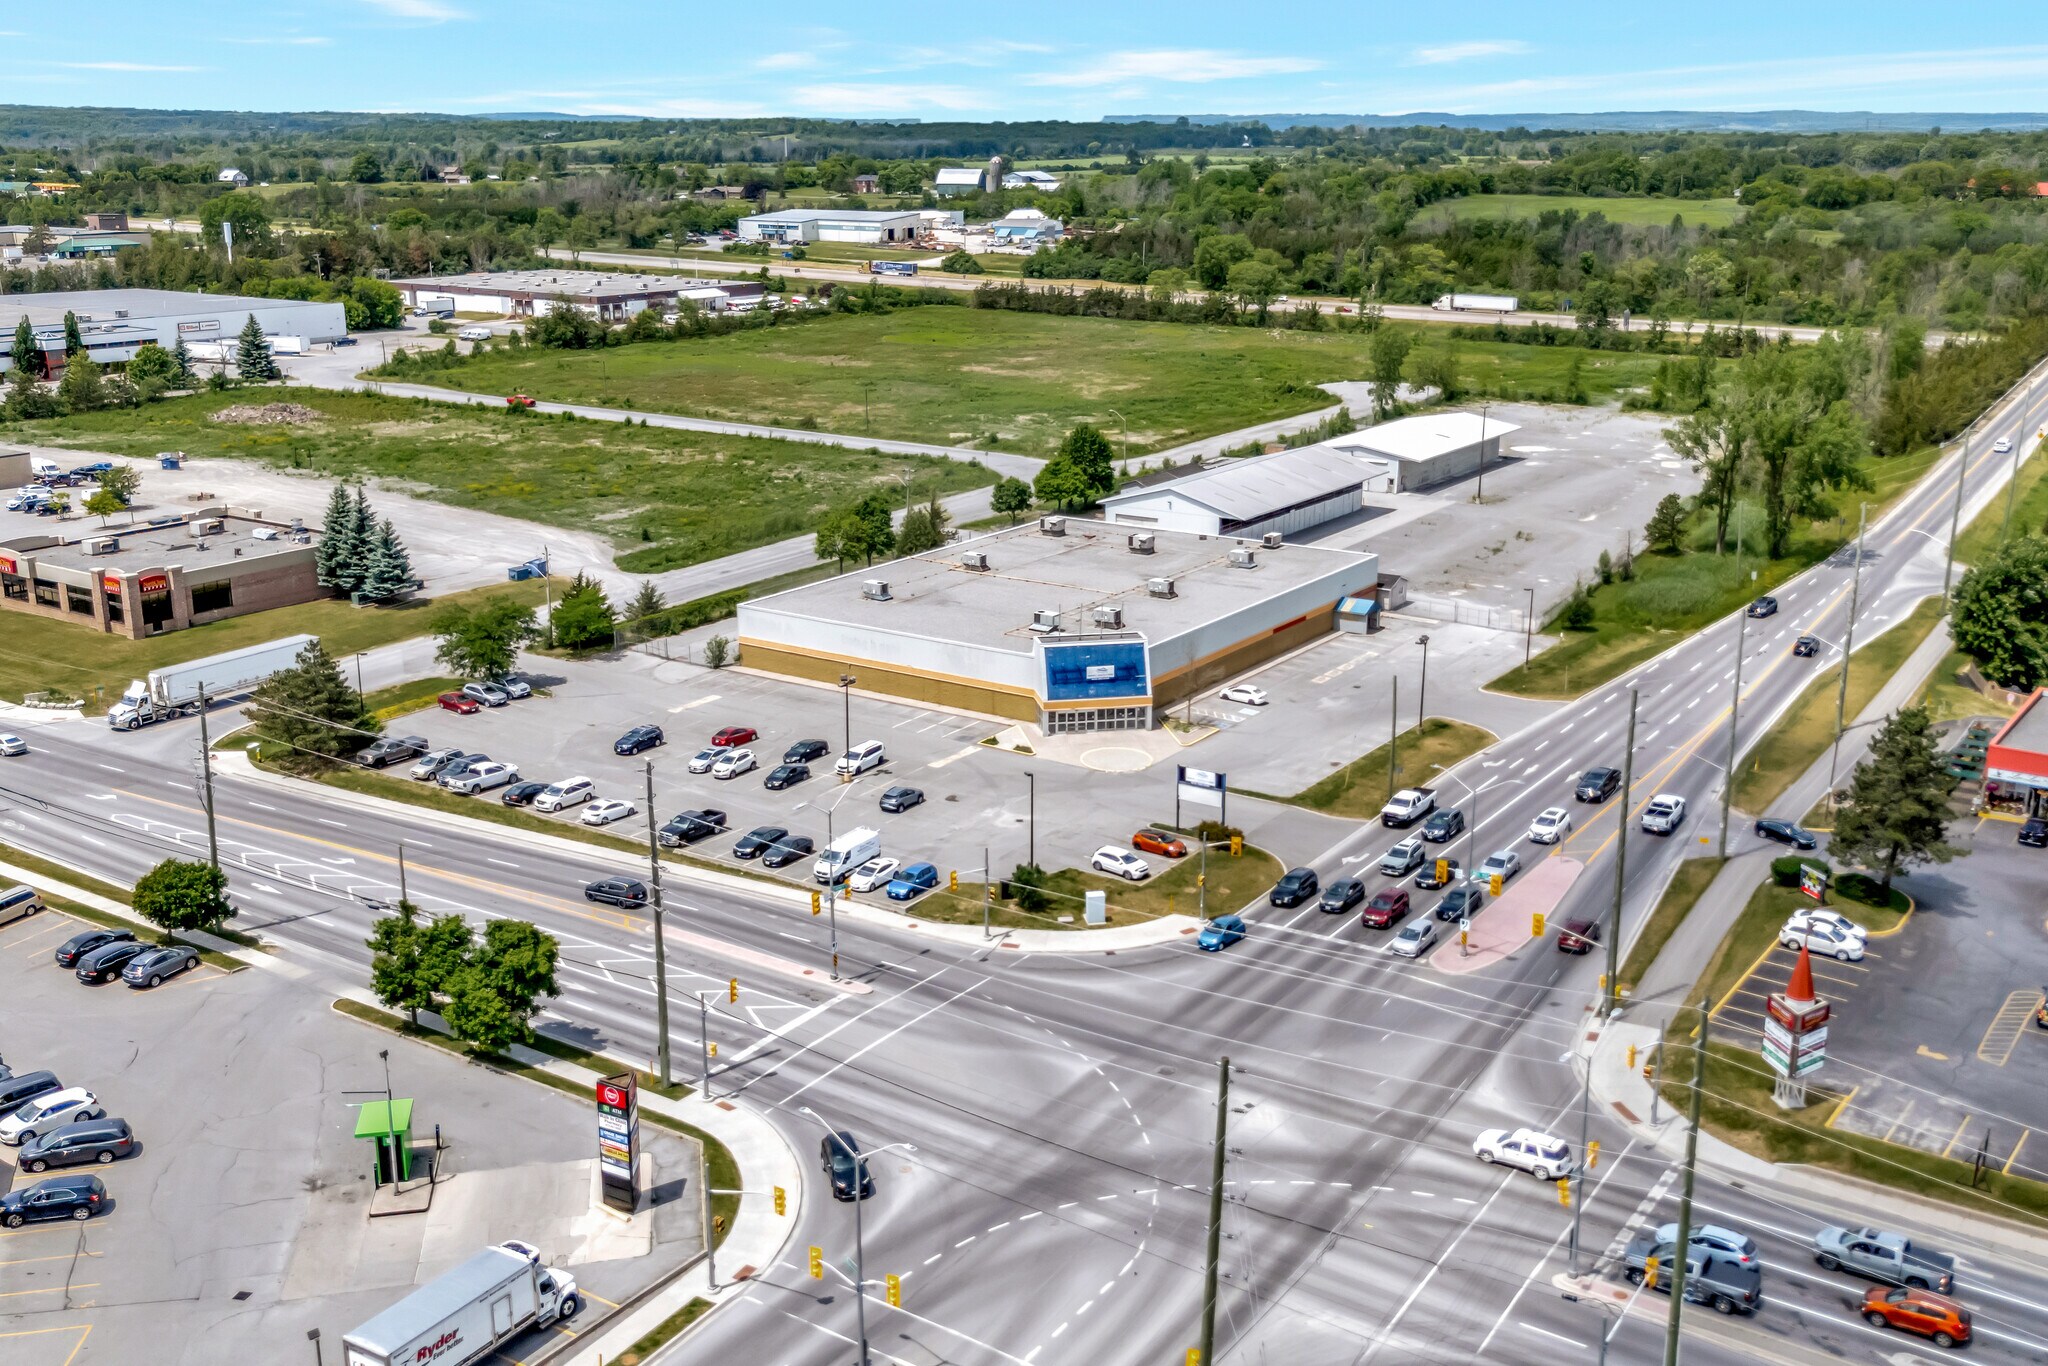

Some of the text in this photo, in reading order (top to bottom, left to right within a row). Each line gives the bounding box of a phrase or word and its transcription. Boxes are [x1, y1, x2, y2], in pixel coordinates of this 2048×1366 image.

[416, 1327, 460, 1363] Ryder
[432, 1336, 464, 1361] Ever better
